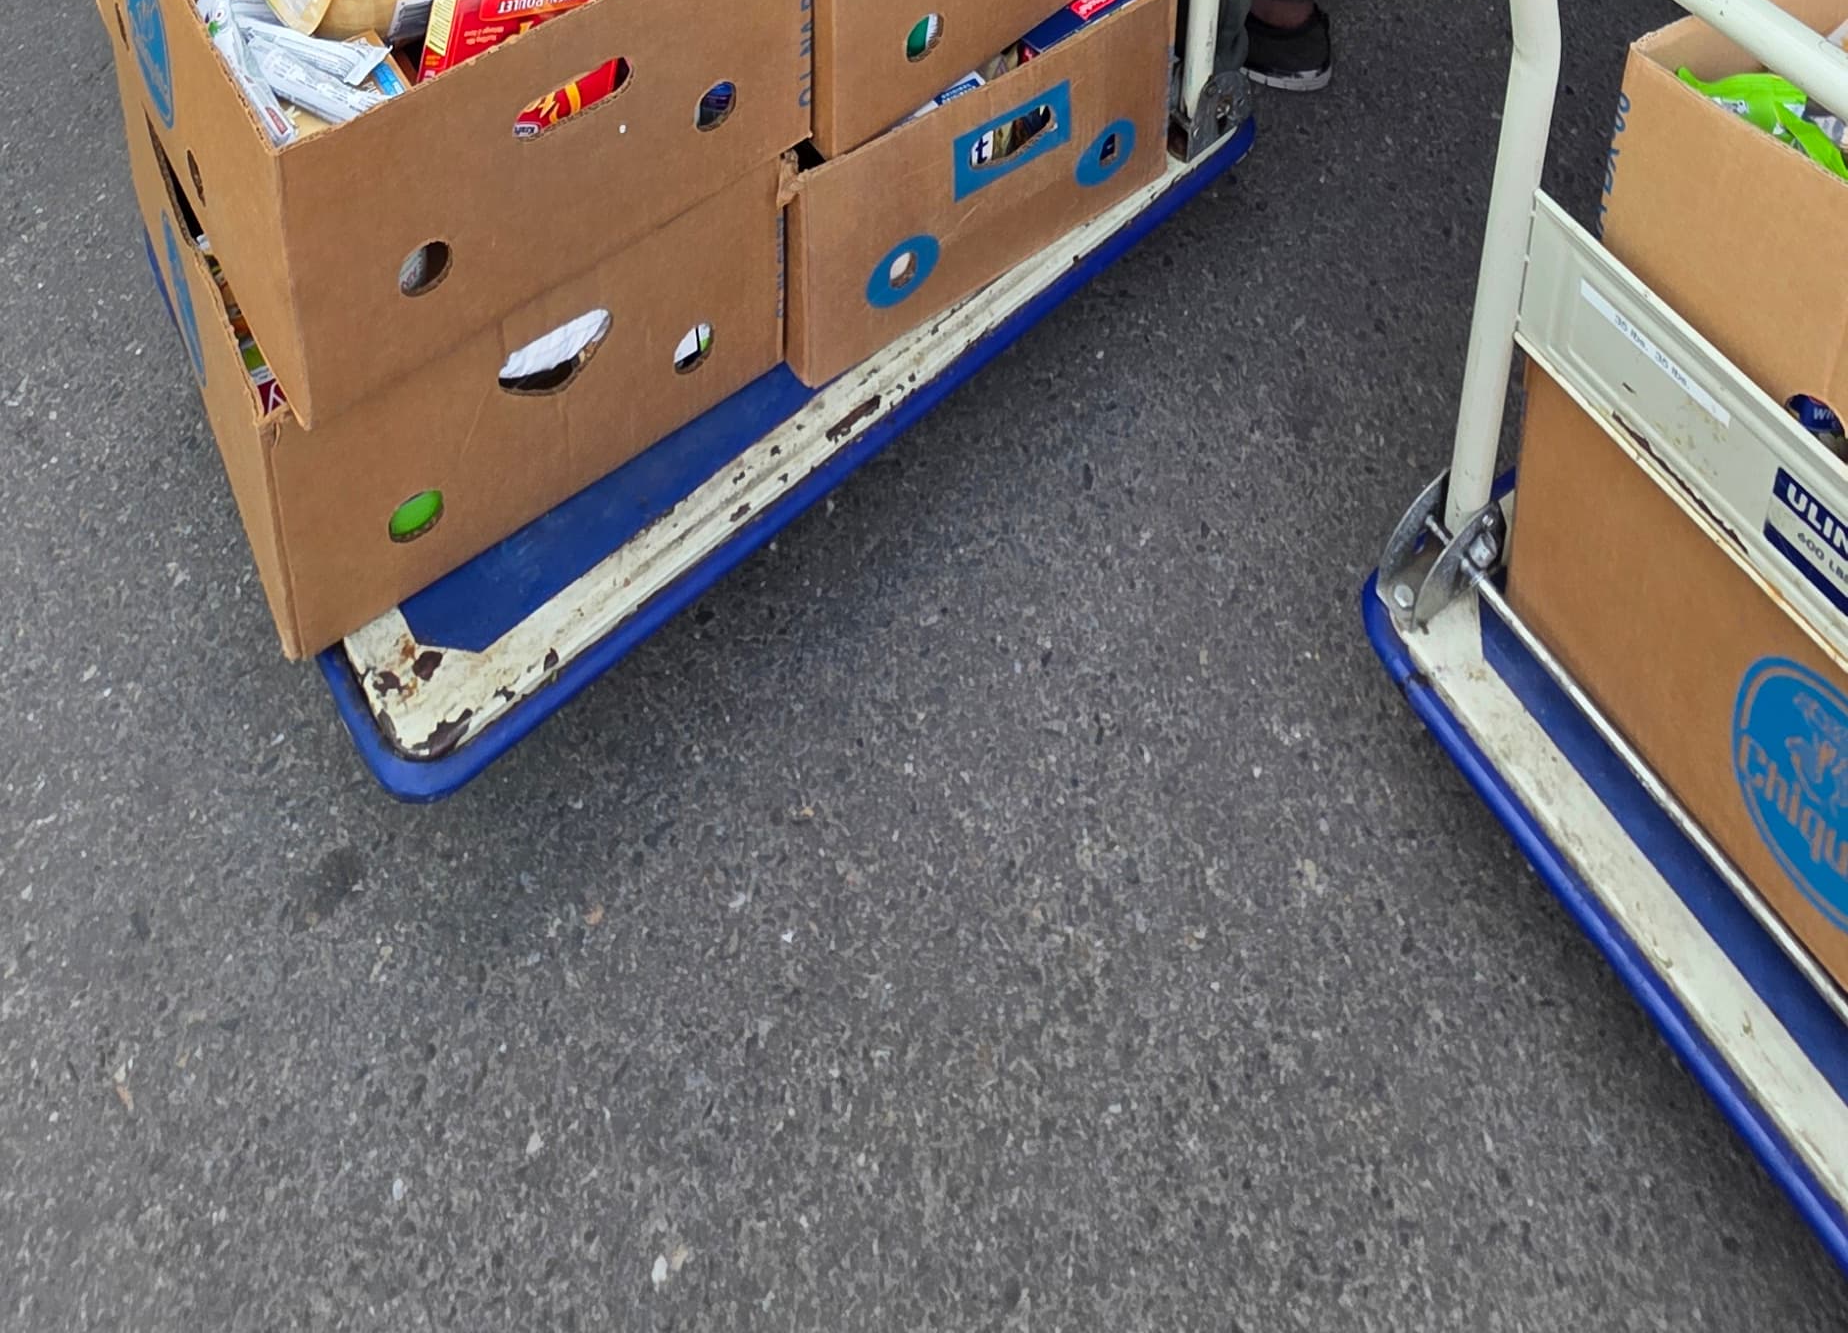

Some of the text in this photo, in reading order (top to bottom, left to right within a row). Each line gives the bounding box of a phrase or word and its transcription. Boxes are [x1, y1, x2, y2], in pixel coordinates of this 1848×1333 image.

[514, 126, 535, 135] Kraft
[1786, 482, 1848, 555] ULIN
[1797, 532, 1825, 561] 600
[1739, 734, 1848, 876] Chiqu
